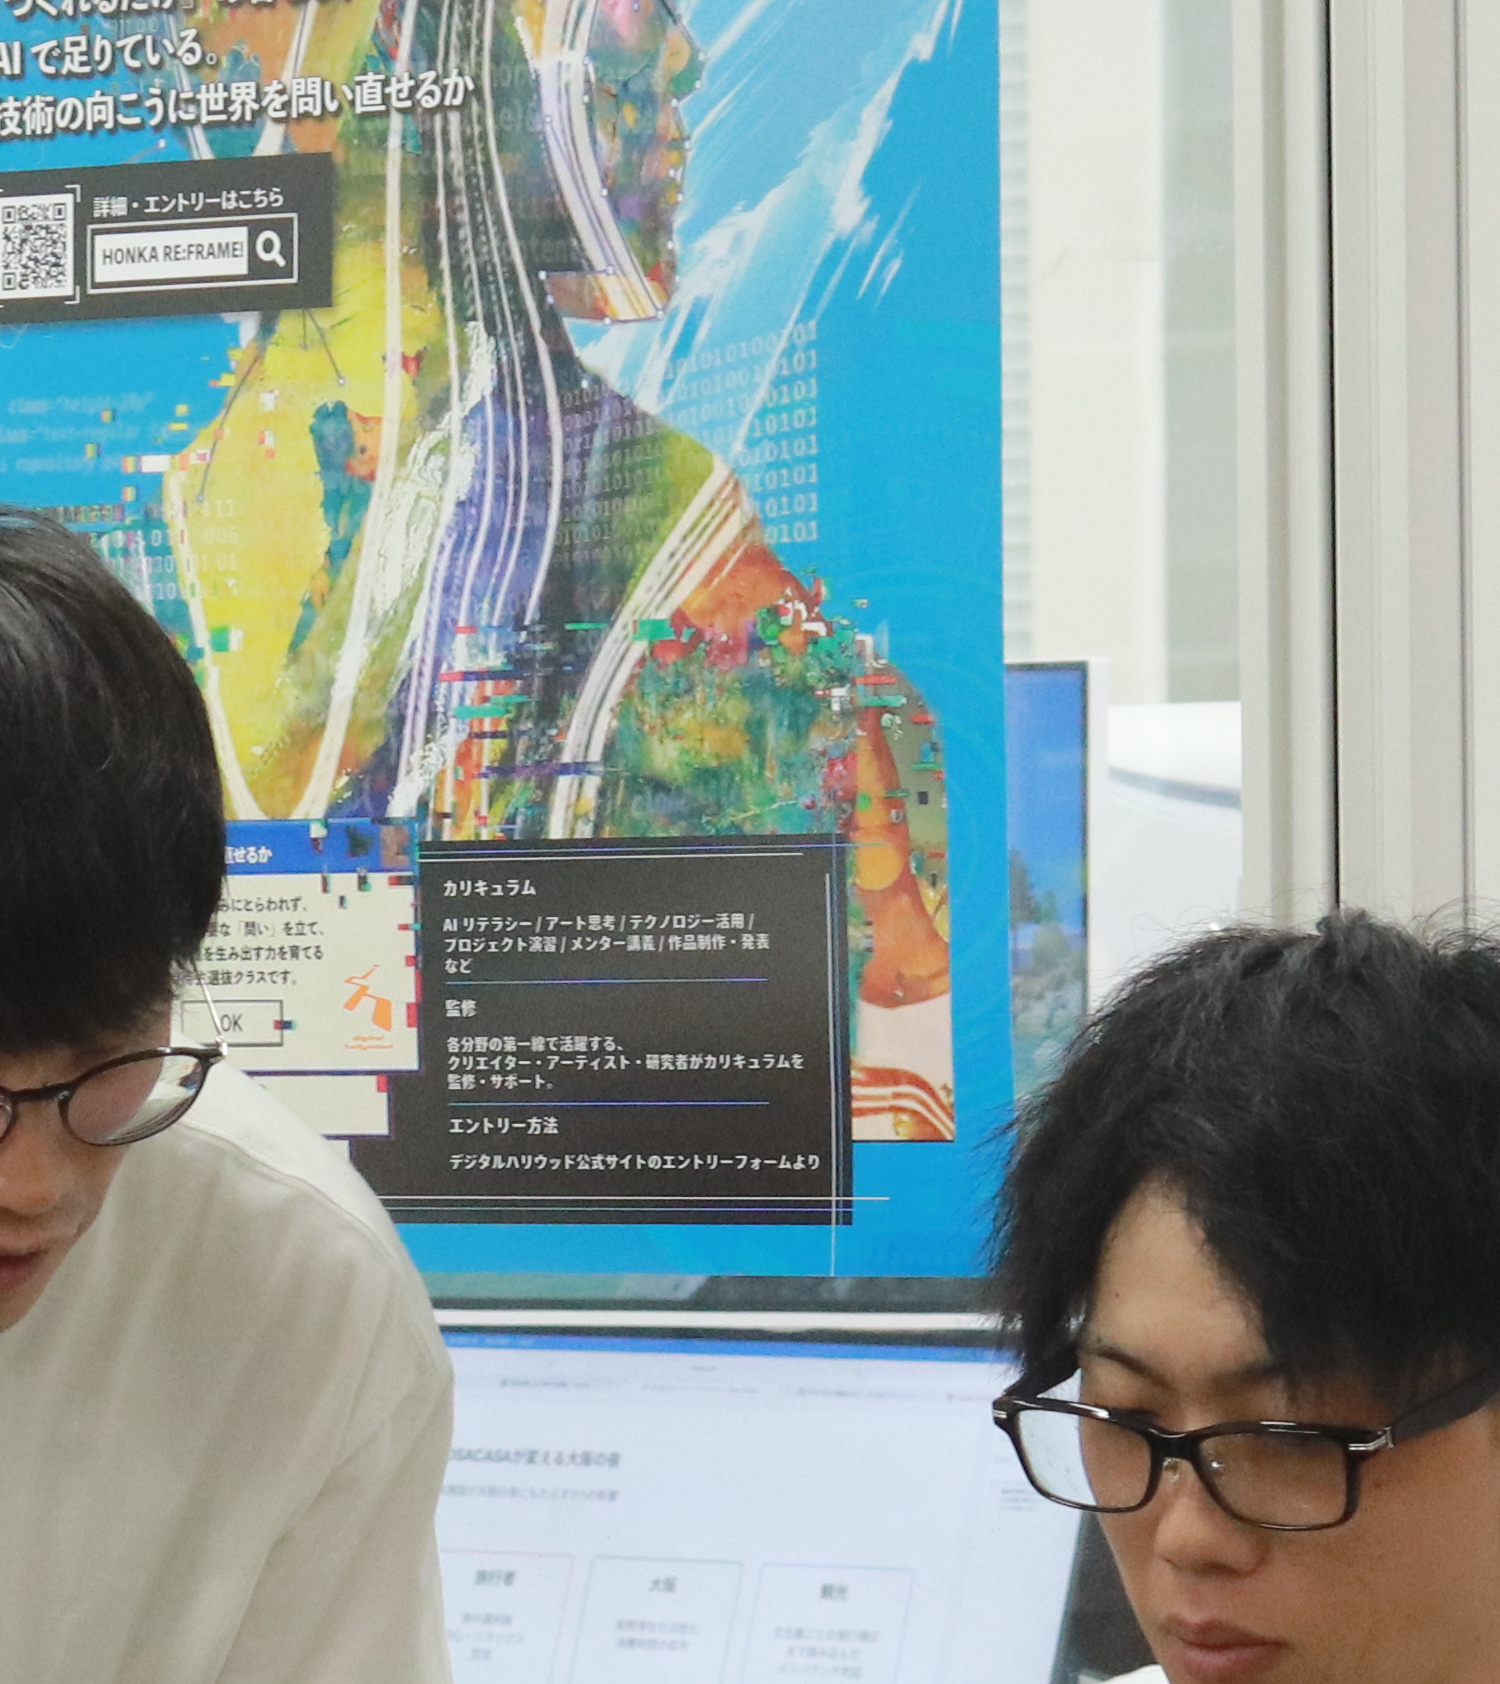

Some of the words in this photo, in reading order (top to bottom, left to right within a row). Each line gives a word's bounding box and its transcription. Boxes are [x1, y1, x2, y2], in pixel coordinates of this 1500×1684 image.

[93, 187, 285, 217] 詳細・エントリーはこちら
[101, 244, 160, 266] HONKA
[163, 240, 245, 264] RE:FRAME!
[442, 878, 537, 898] カリキュラム
[444, 957, 473, 975] など
[444, 999, 478, 1019] 監修
[219, 1013, 244, 1033] OK
[446, 1035, 624, 1053] 各分野の第一線で活躍する、
[447, 1053, 805, 1072] クリエイター・アーティスト・研究者がカリキュラムを
[446, 1073, 554, 1091] 監修・サポート。
[449, 1116, 560, 1135] エントリー方法
[449, 1152, 821, 1171] デジタルハリウッド公式サイトのエントリーフォームより
